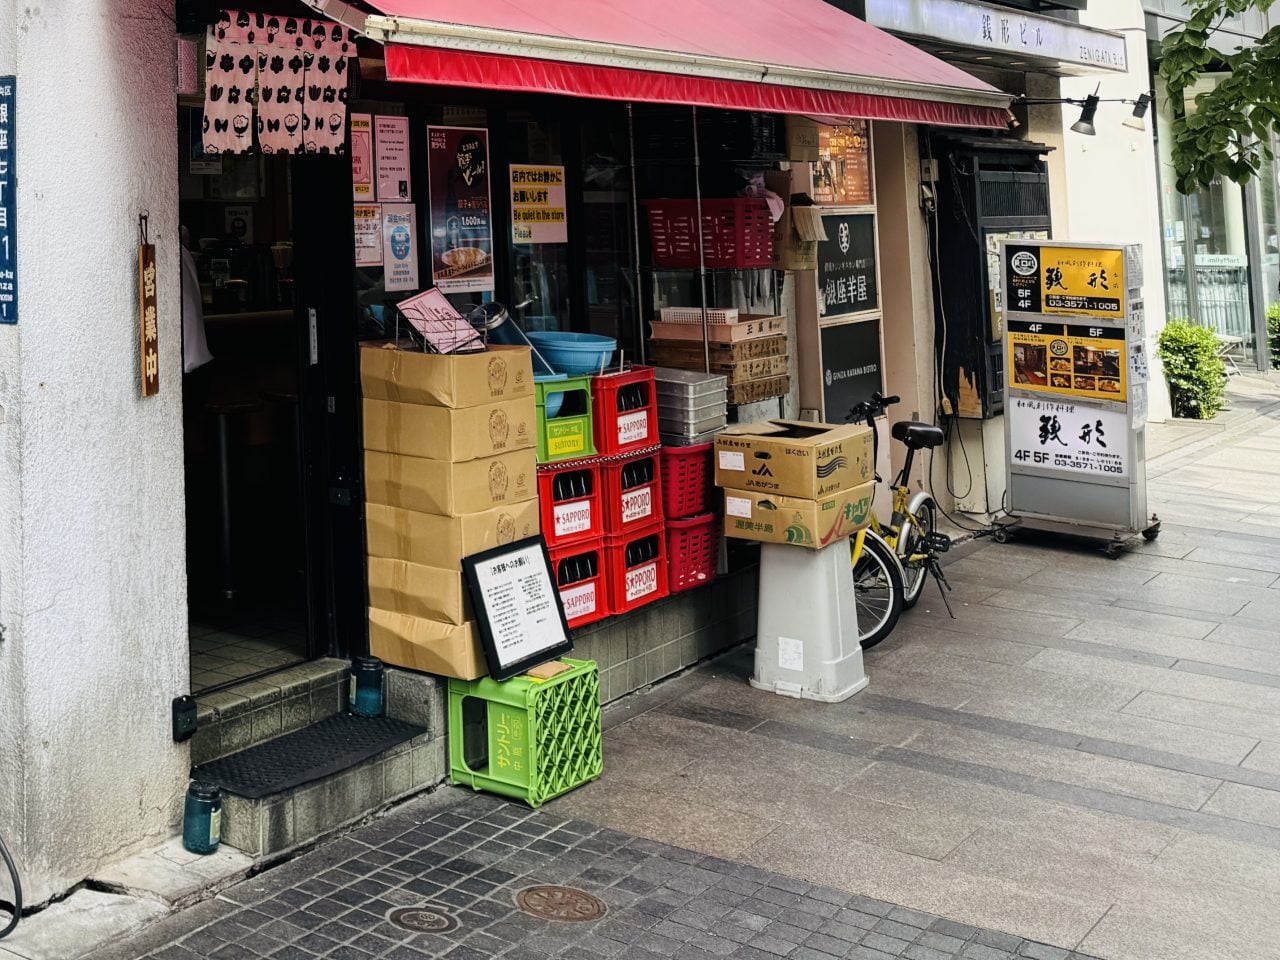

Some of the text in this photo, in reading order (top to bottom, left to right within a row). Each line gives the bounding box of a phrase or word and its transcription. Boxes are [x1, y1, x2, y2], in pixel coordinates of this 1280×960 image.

[982, 13, 1044, 48] 銭形ビル
[1079, 45, 1112, 65] ZENIGATA
[513, 190, 548, 203] お願いします
[514, 210, 521, 220] Be
[522, 210, 535, 222] quiet
[542, 210, 550, 220] the
[551, 210, 564, 220] store
[826, 274, 867, 306] 銀座羊屋
[1018, 289, 1031, 298] 5F
[1018, 300, 1031, 309] 4F
[1049, 299, 1118, 310] 03-3571-1005
[144, 262, 157, 383] 営業中
[1029, 323, 1042, 332] 4F
[1089, 328, 1103, 337] 5F
[623, 418, 647, 434] SAPPORO
[785, 447, 809, 457] はくさい
[1014, 449, 1049, 464] 4F 5F
[1054, 459, 1123, 474] 03-3571-1005
[746, 480, 780, 490] JAあがつま
[562, 508, 590, 525] SAPPORO
[735, 519, 774, 534] 渥美半島
[567, 592, 595, 610] SAPPORO
